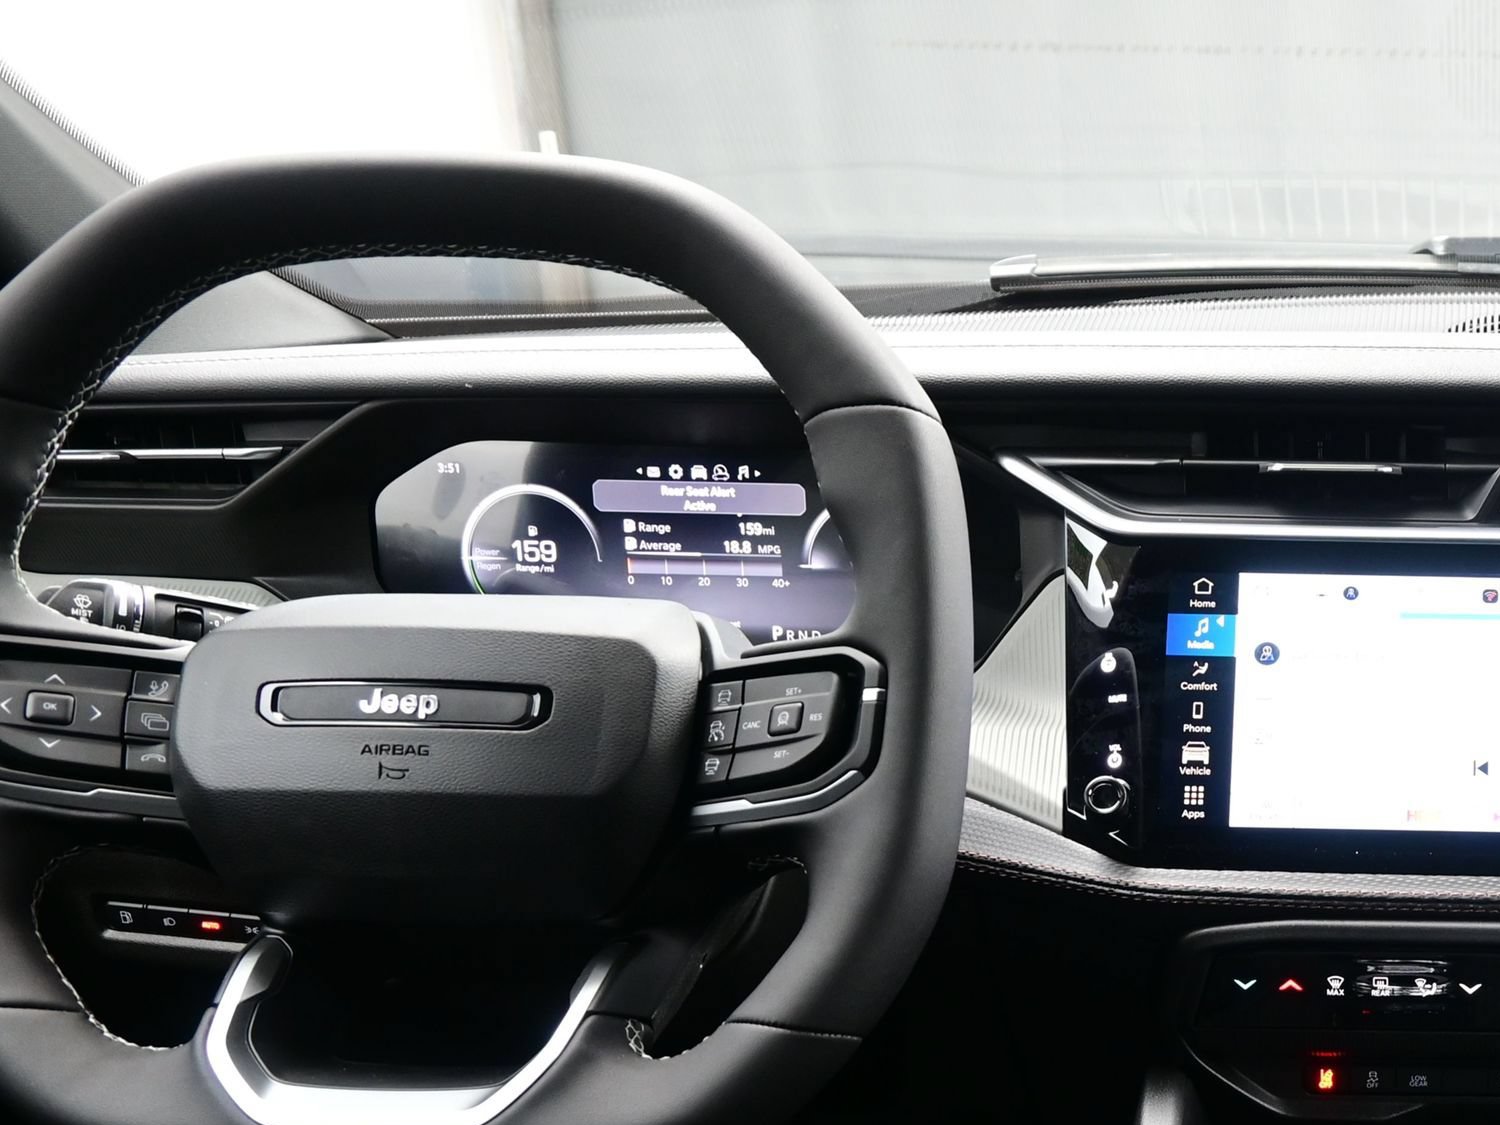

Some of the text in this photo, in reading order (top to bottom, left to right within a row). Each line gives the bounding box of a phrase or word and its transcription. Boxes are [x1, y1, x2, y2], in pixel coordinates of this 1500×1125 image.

[437, 462, 460, 474] 3:51
[660, 485, 736, 498] Rear Seat Alert
[683, 500, 717, 512] Active
[638, 521, 671, 535] Range
[511, 539, 558, 563] 159
[639, 540, 781, 555] Average 18.8 MPG
[627, 577, 790, 588] 0 10 20 30 40+
[1189, 599, 1216, 608] Home
[71, 607, 93, 618] MIST
[1187, 640, 1215, 650] Media
[1180, 682, 1218, 691] Comfort
[42, 702, 57, 711] OK
[359, 688, 438, 719] Jeep
[809, 713, 823, 721] RES
[742, 721, 761, 730] CANC
[1183, 724, 1211, 733] Phone
[360, 744, 430, 756] AIRBAG
[1179, 766, 1211, 775] Vehicle
[1181, 809, 1205, 819] Apps
[1371, 989, 1390, 997] REAR
